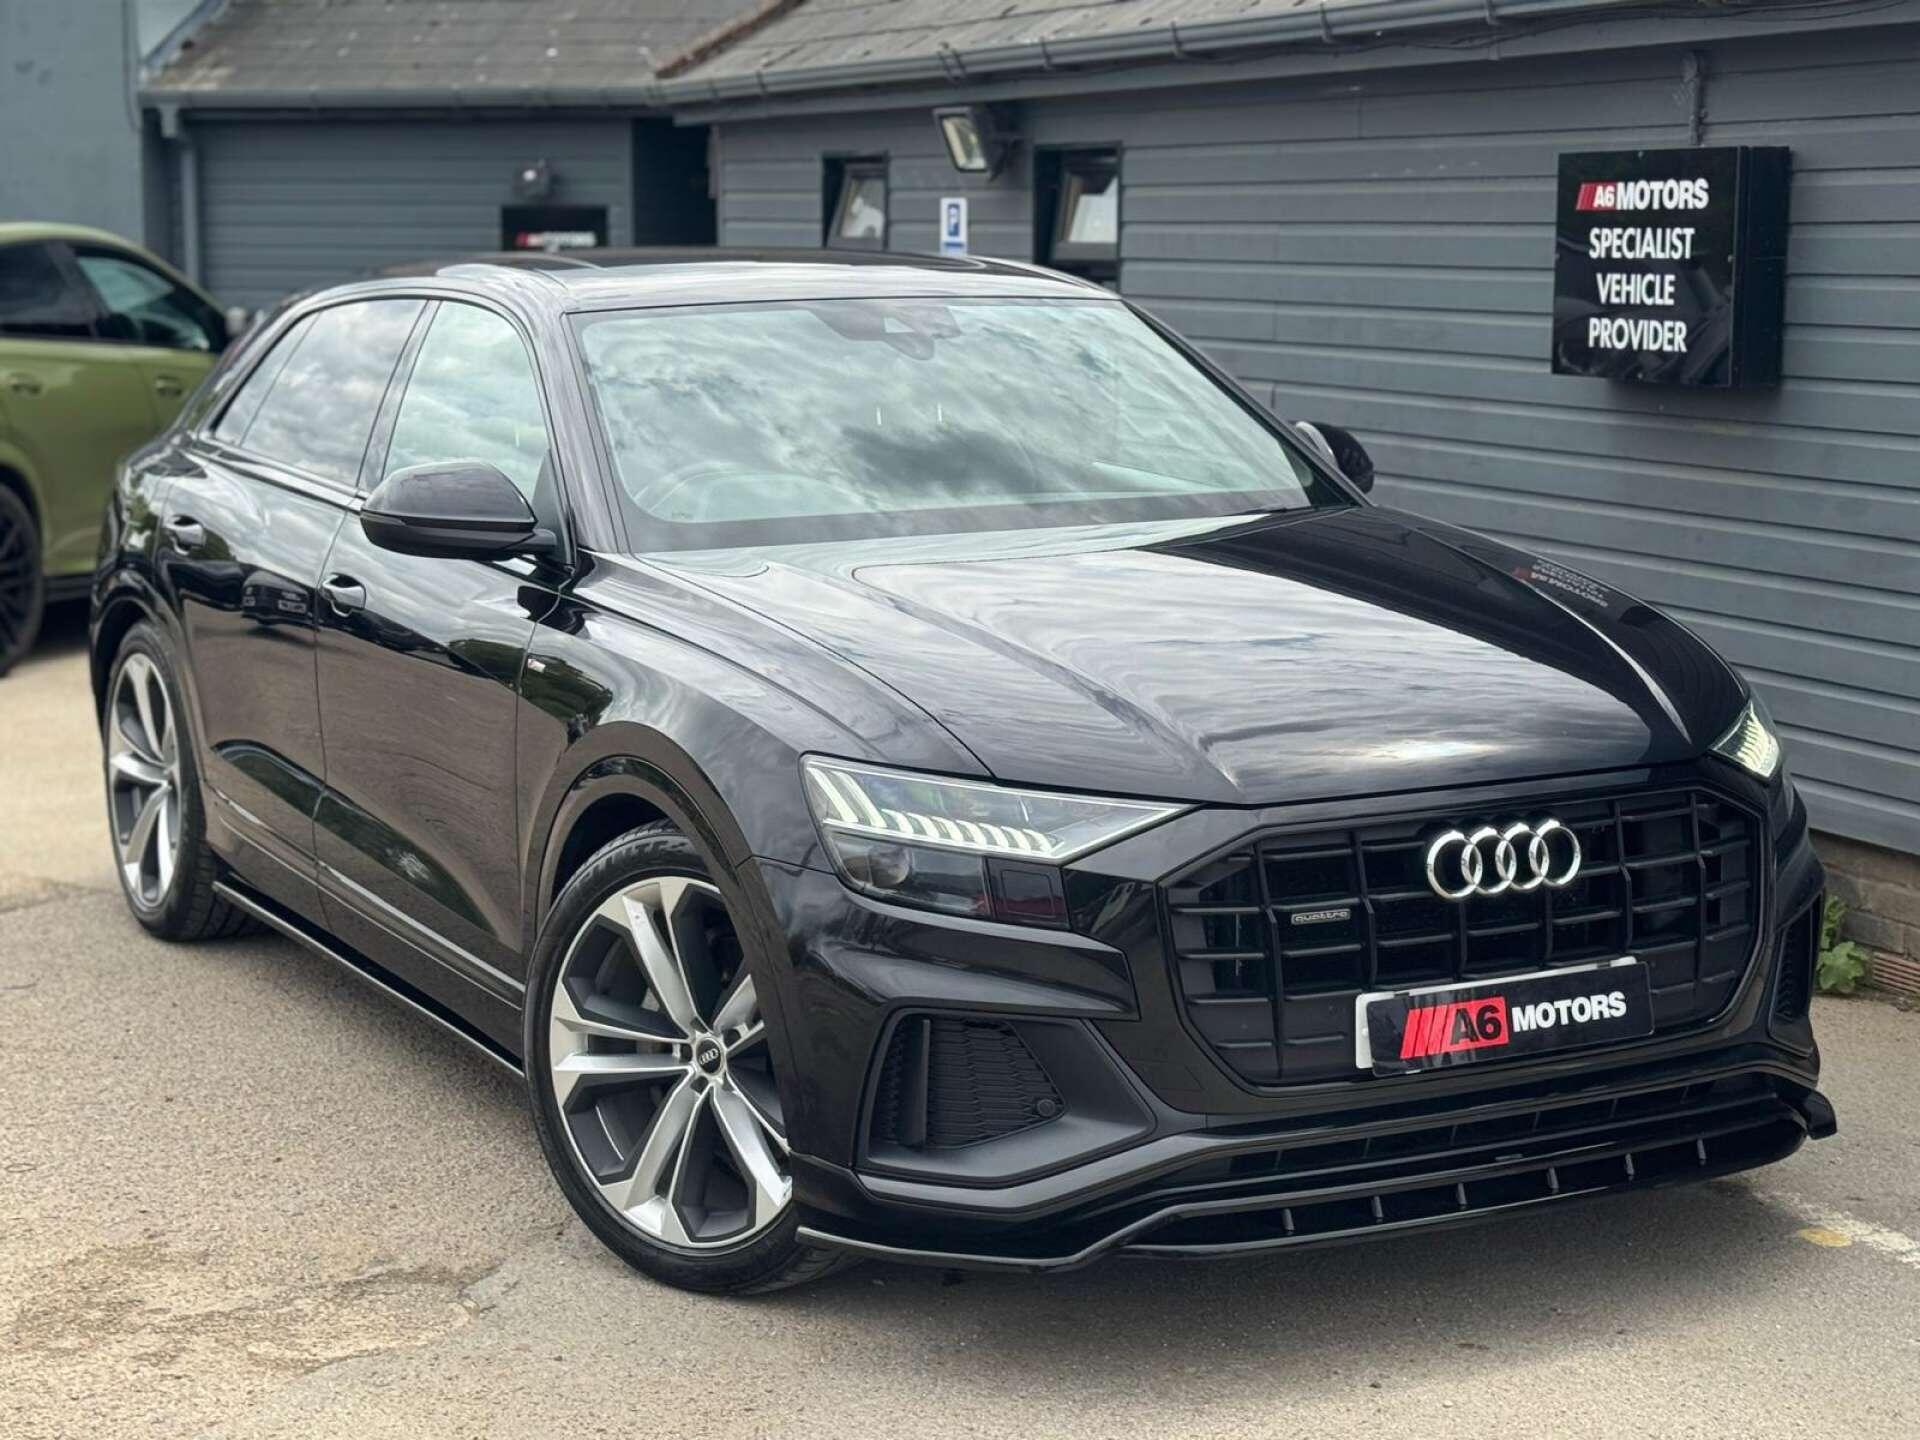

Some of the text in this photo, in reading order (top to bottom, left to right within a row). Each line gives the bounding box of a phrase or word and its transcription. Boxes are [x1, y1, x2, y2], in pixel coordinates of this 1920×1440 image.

[1593, 178, 1709, 210] A6 MOTORS
[1588, 227, 1695, 259] SPECIALIST
[1596, 273, 1676, 305] VEHICLE
[1588, 317, 1687, 352] PROVIDER
[1293, 910, 1348, 924] quattro
[1448, 991, 1627, 1045] A6 MOTORS
